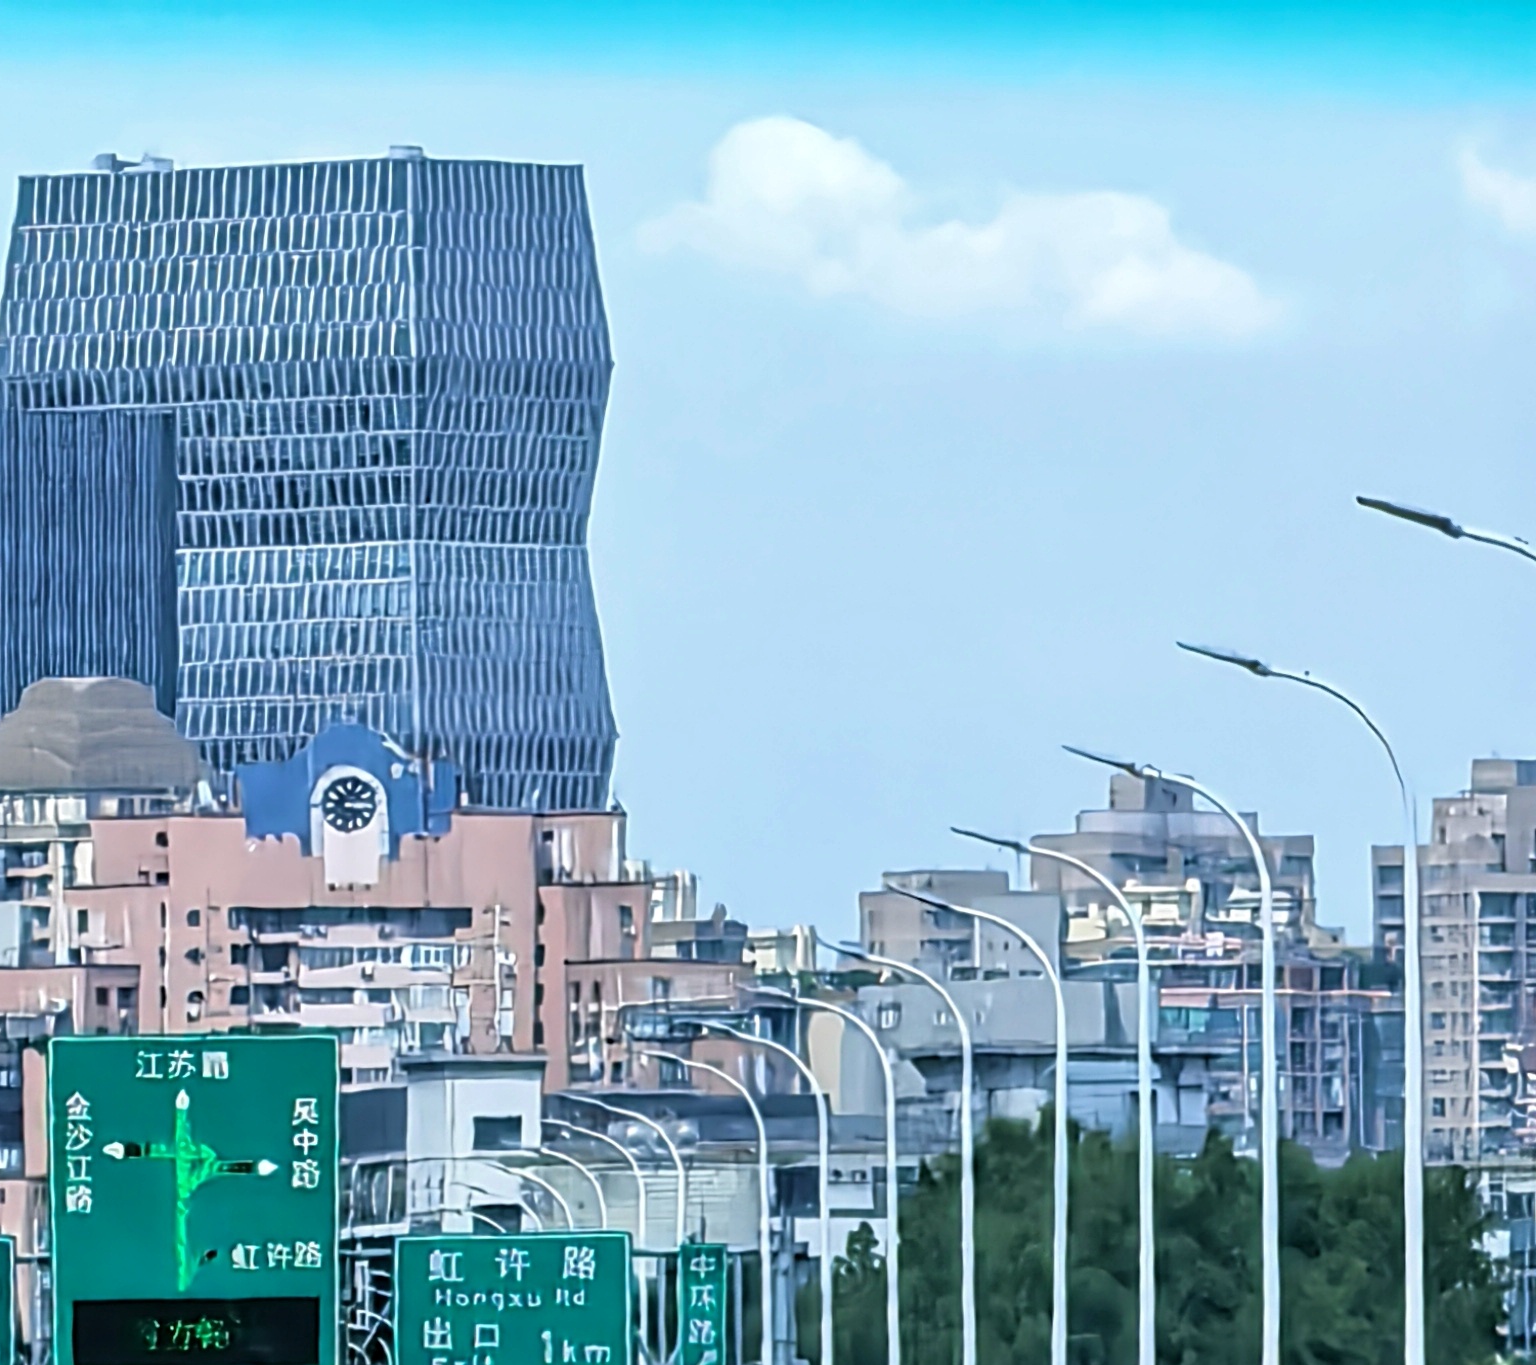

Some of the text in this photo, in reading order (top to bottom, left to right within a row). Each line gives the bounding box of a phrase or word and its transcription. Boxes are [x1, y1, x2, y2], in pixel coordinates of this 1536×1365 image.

[65, 1090, 94, 1214] 金沙江路
[231, 1241, 323, 1271] 虹许路
[428, 1245, 596, 1282] 虹许路
[435, 1288, 542, 1312] Hongxu
[423, 1316, 500, 1350] 出口
